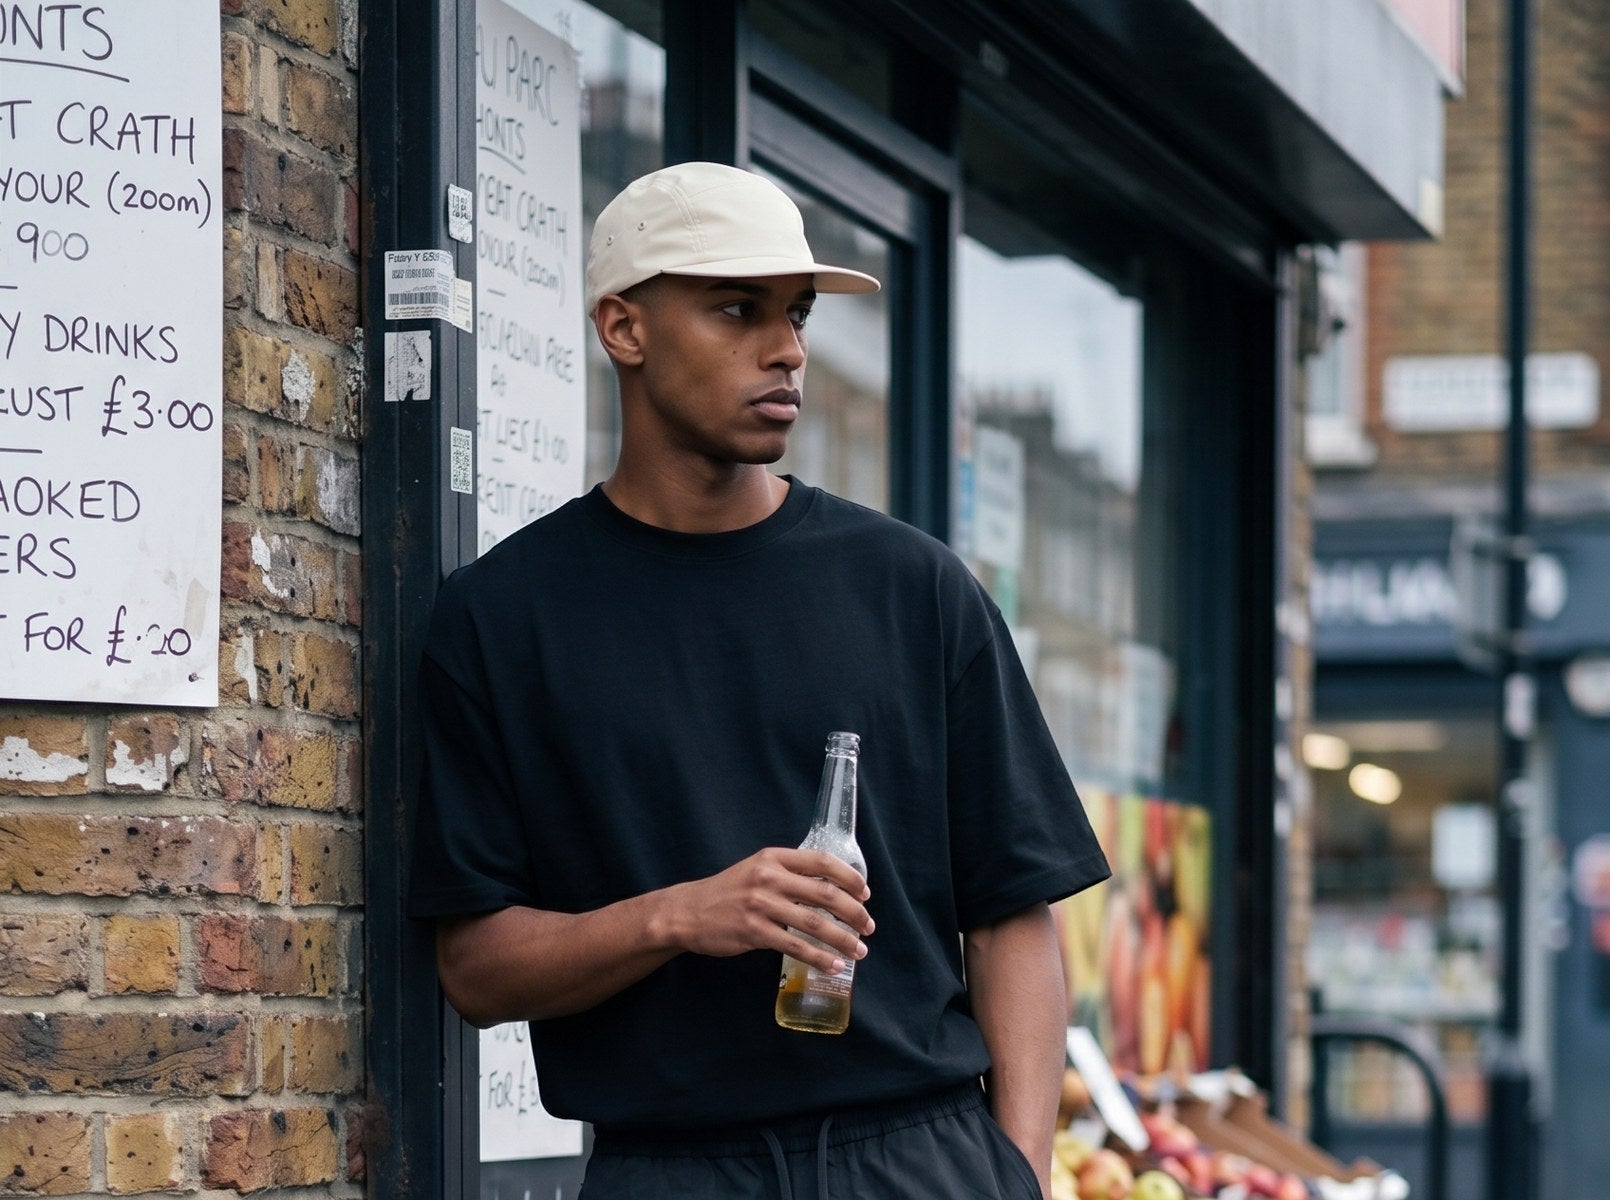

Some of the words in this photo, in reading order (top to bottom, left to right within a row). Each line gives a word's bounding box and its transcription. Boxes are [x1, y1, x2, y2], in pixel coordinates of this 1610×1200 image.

[0, 3, 113, 61] NTS
[0, 100, 32, 140] T
[57, 102, 195, 164] CRATH
[107, 170, 211, 229] (200m)
[16, 222, 89, 263] 900
[44, 313, 178, 364] DRINKS
[25, 612, 92, 656] FOR
